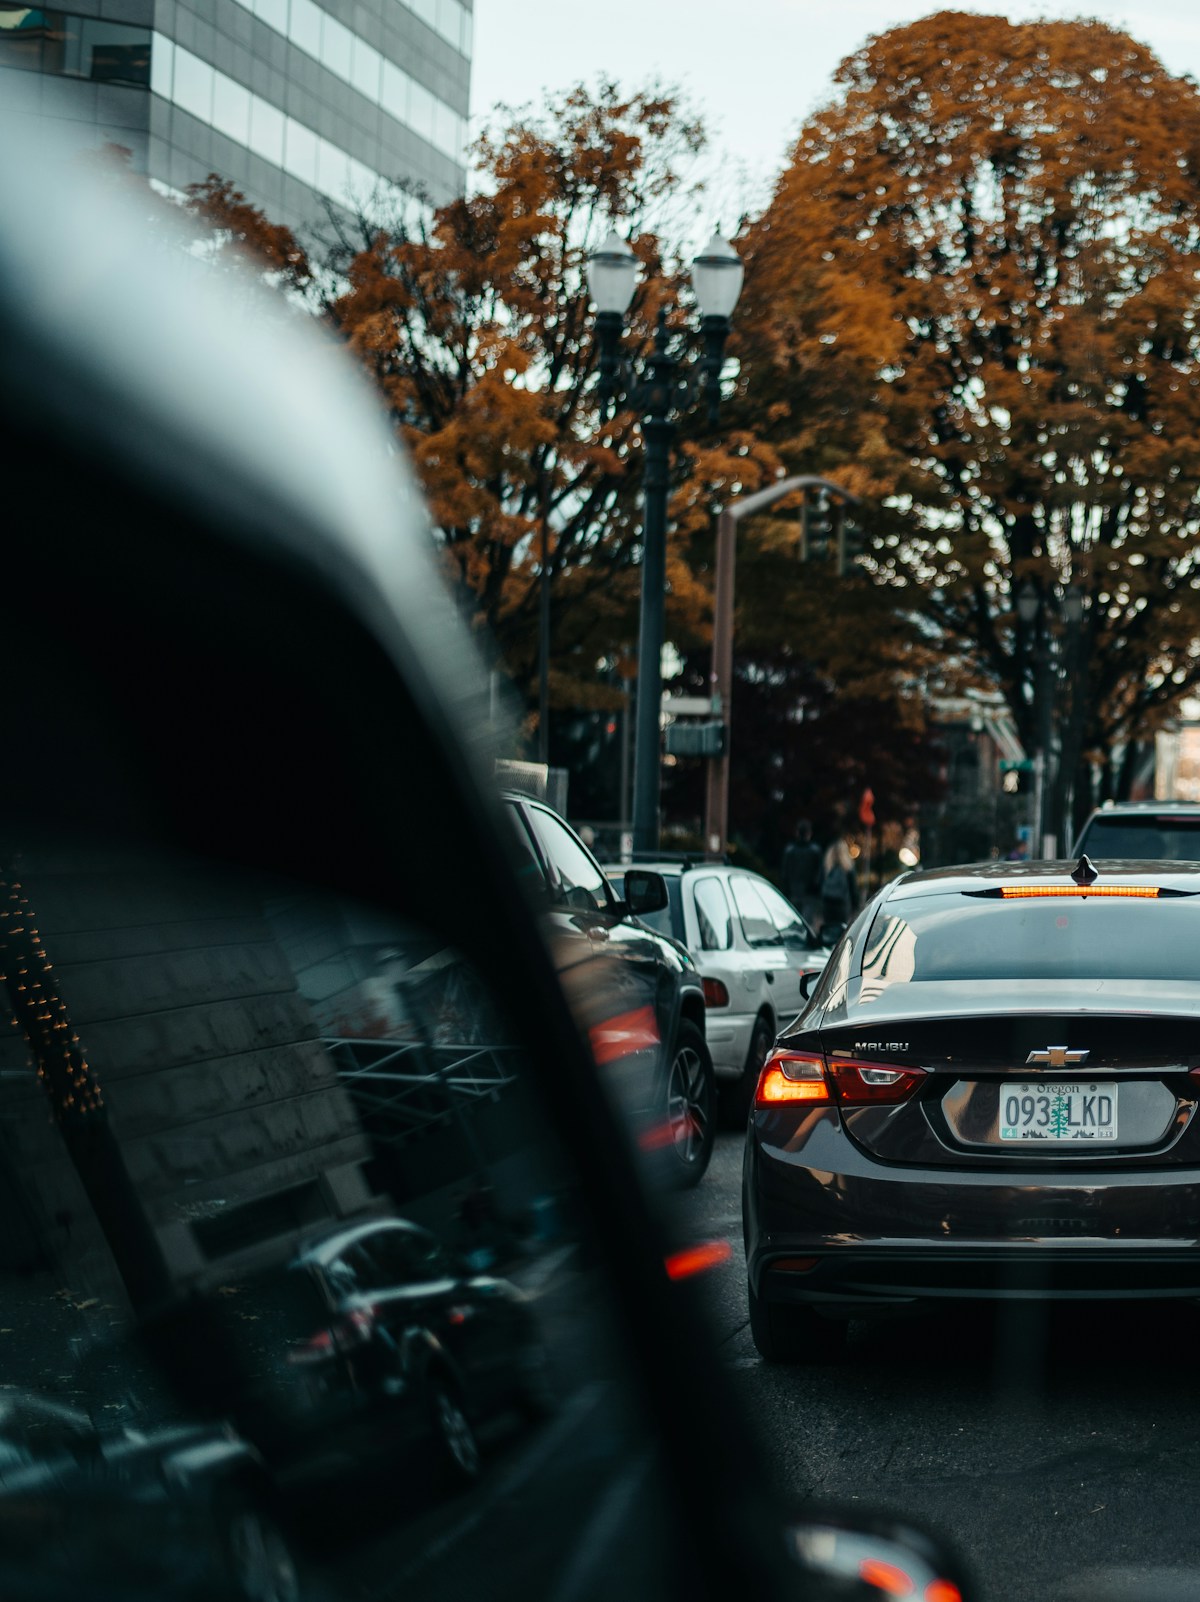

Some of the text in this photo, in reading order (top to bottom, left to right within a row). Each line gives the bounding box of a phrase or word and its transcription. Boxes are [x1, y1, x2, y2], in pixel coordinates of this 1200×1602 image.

[855, 1042, 909, 1051] MALIBU
[1037, 1084, 1080, 1095] Oregon
[1006, 1096, 1112, 1126] 093 LKD
